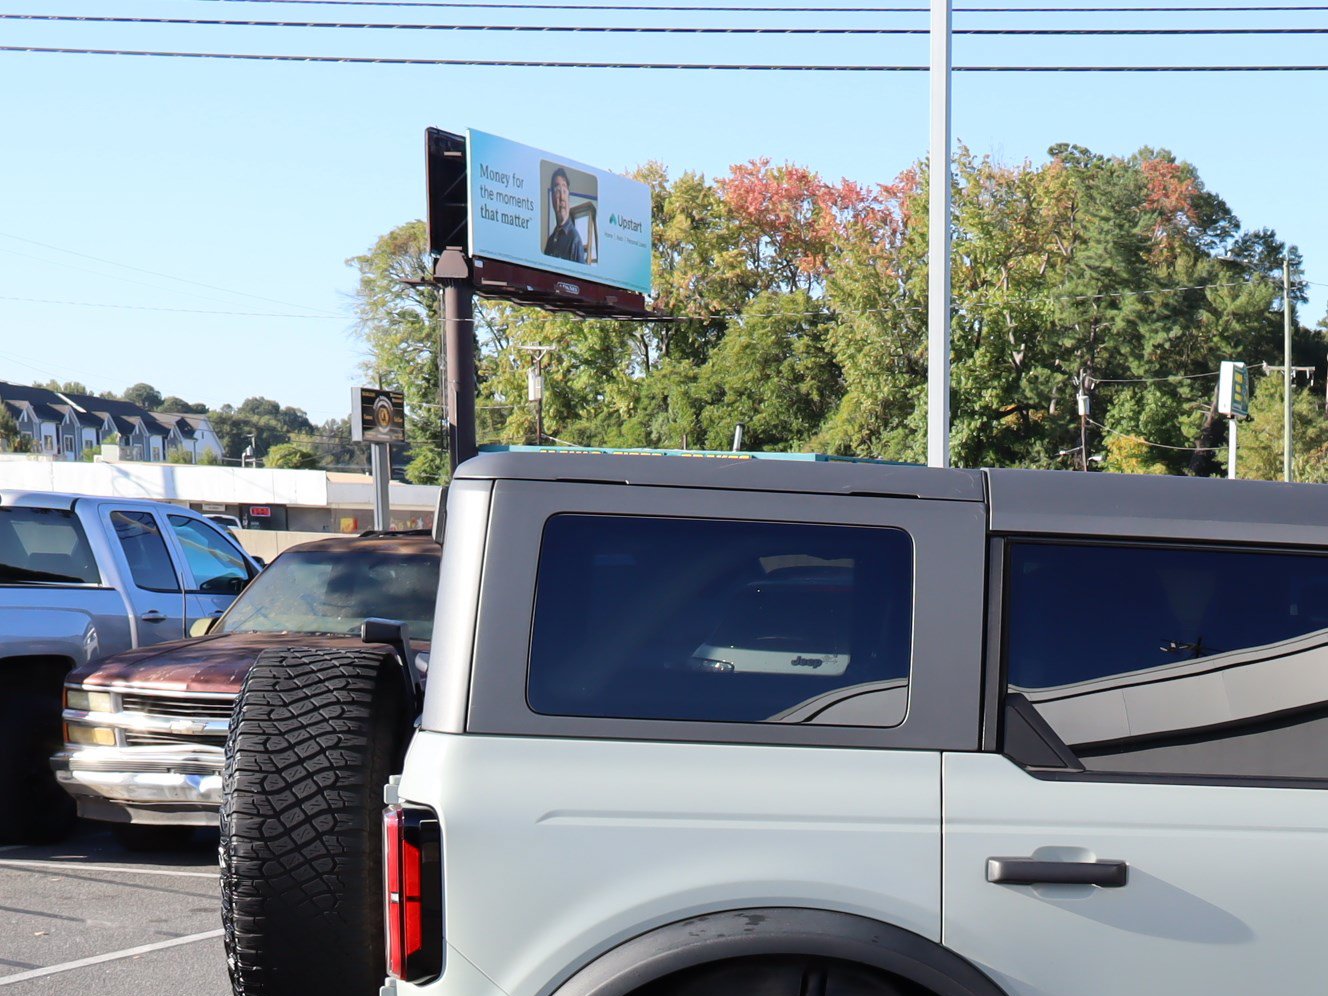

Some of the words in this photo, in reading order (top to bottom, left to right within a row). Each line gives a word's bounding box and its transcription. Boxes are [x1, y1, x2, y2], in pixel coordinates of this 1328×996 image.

[480, 163, 510, 188] Money
[512, 172, 524, 189] for
[480, 184, 494, 201] the
[496, 191, 535, 211] moments
[480, 203, 499, 222] that
[617, 213, 642, 233] Upstart
[791, 655, 822, 669] Jeep
